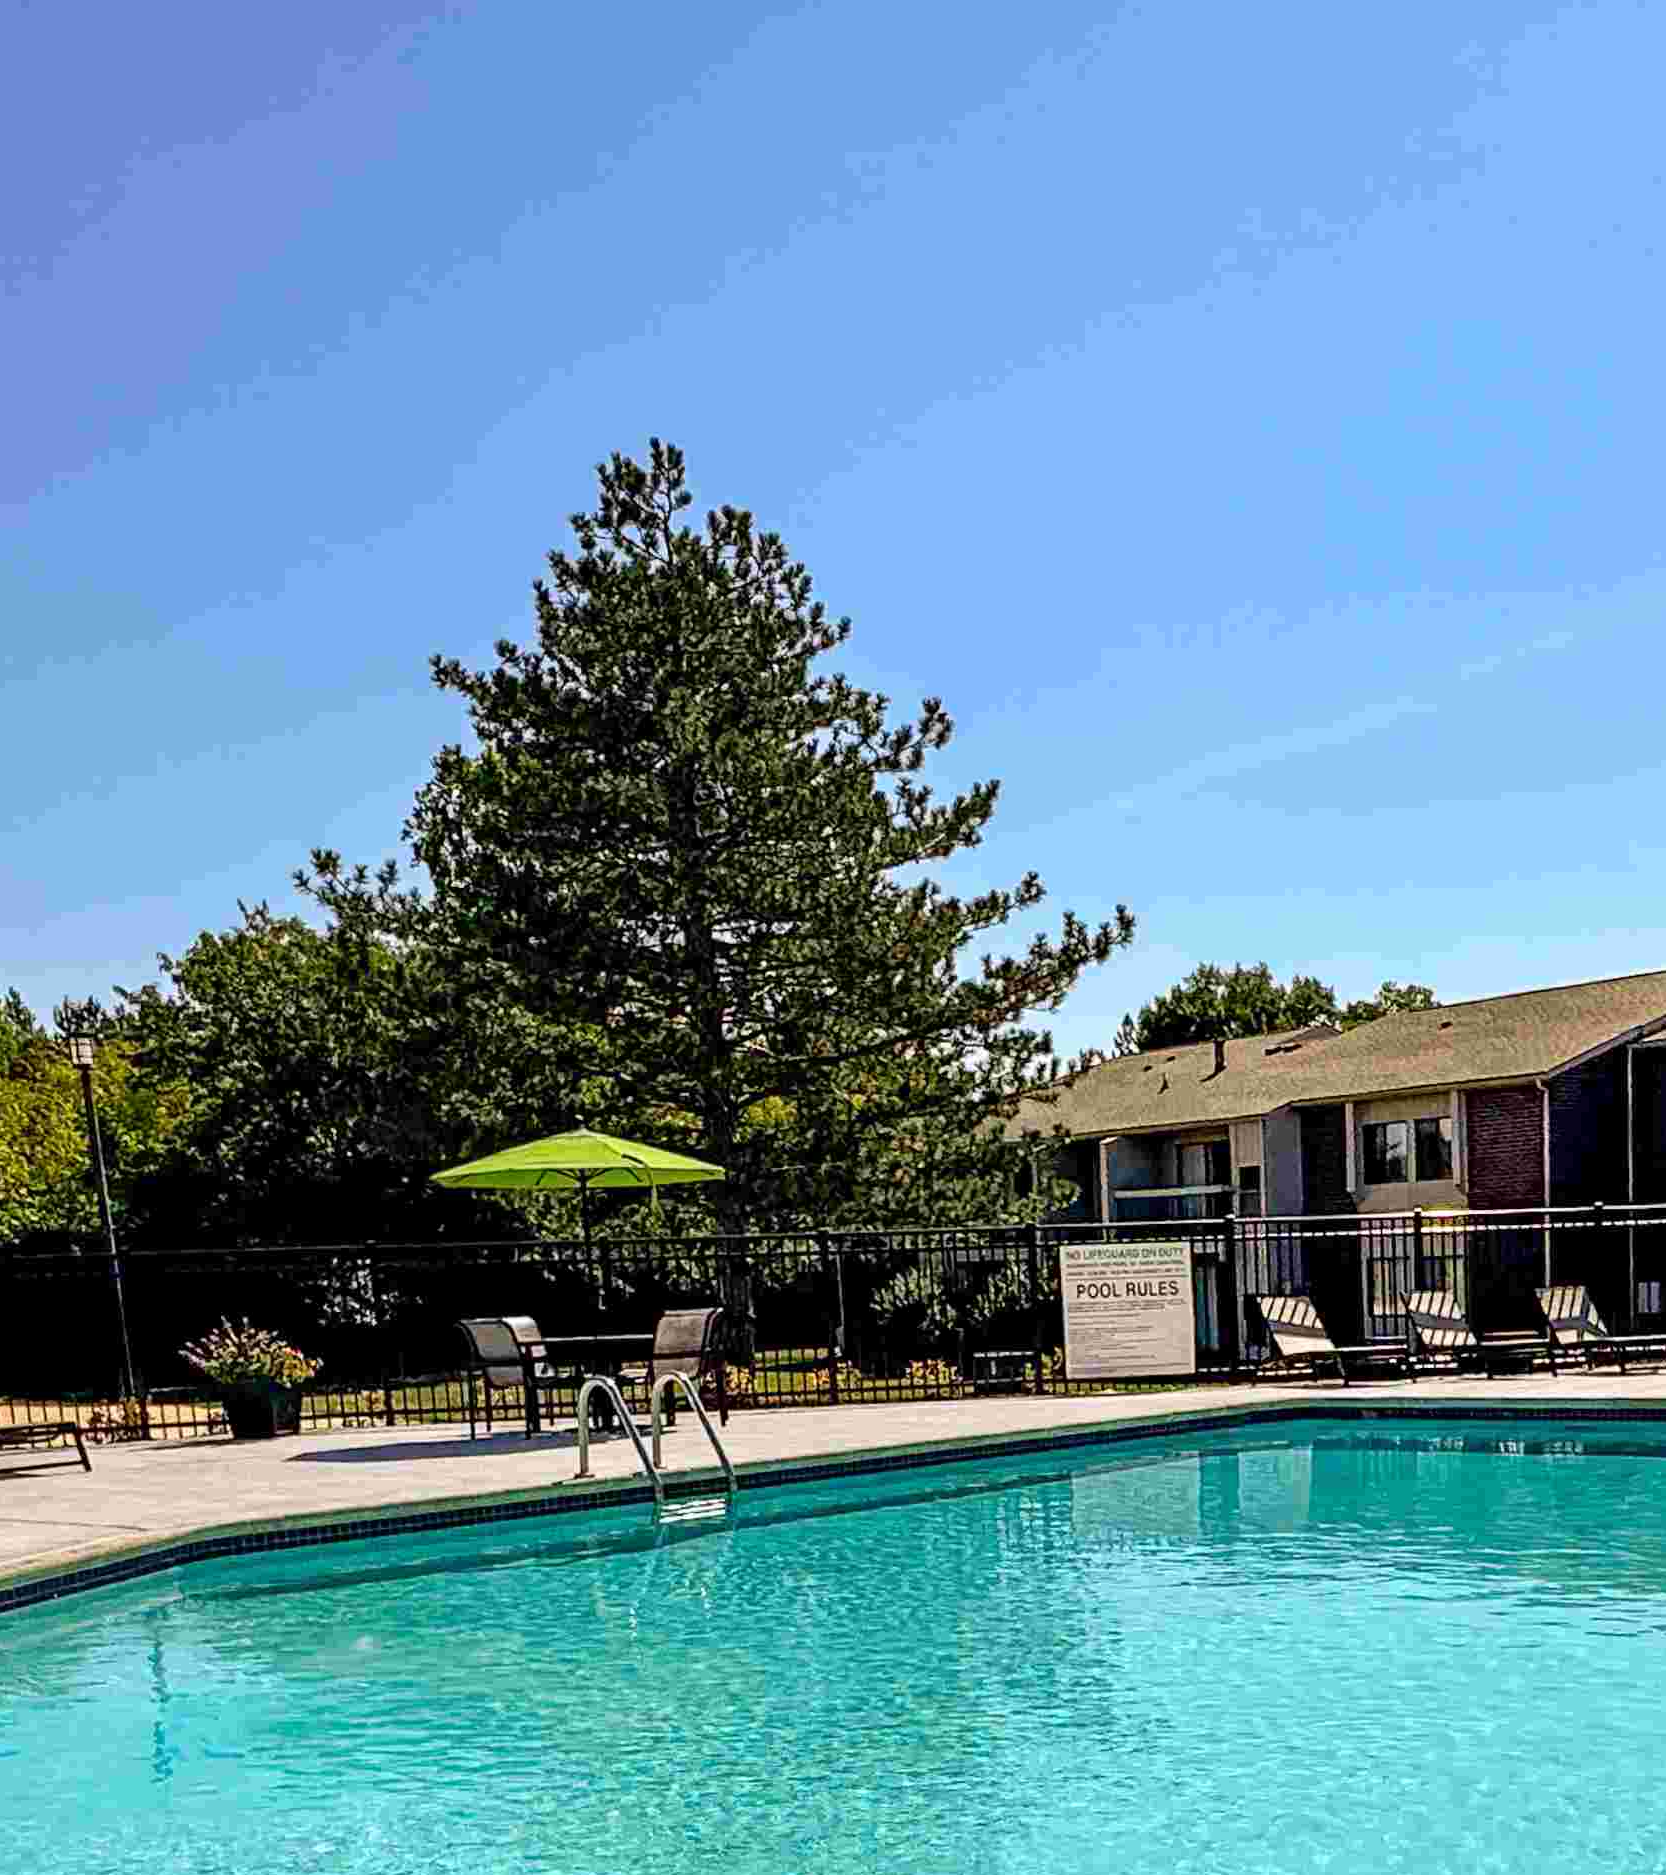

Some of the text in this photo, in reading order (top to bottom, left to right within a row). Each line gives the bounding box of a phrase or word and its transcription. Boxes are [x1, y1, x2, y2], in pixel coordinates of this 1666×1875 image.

[1065, 1247, 1183, 1260] NO LIFEGUARD ON DUTY
[1076, 1280, 1179, 1299] POOL RULES
